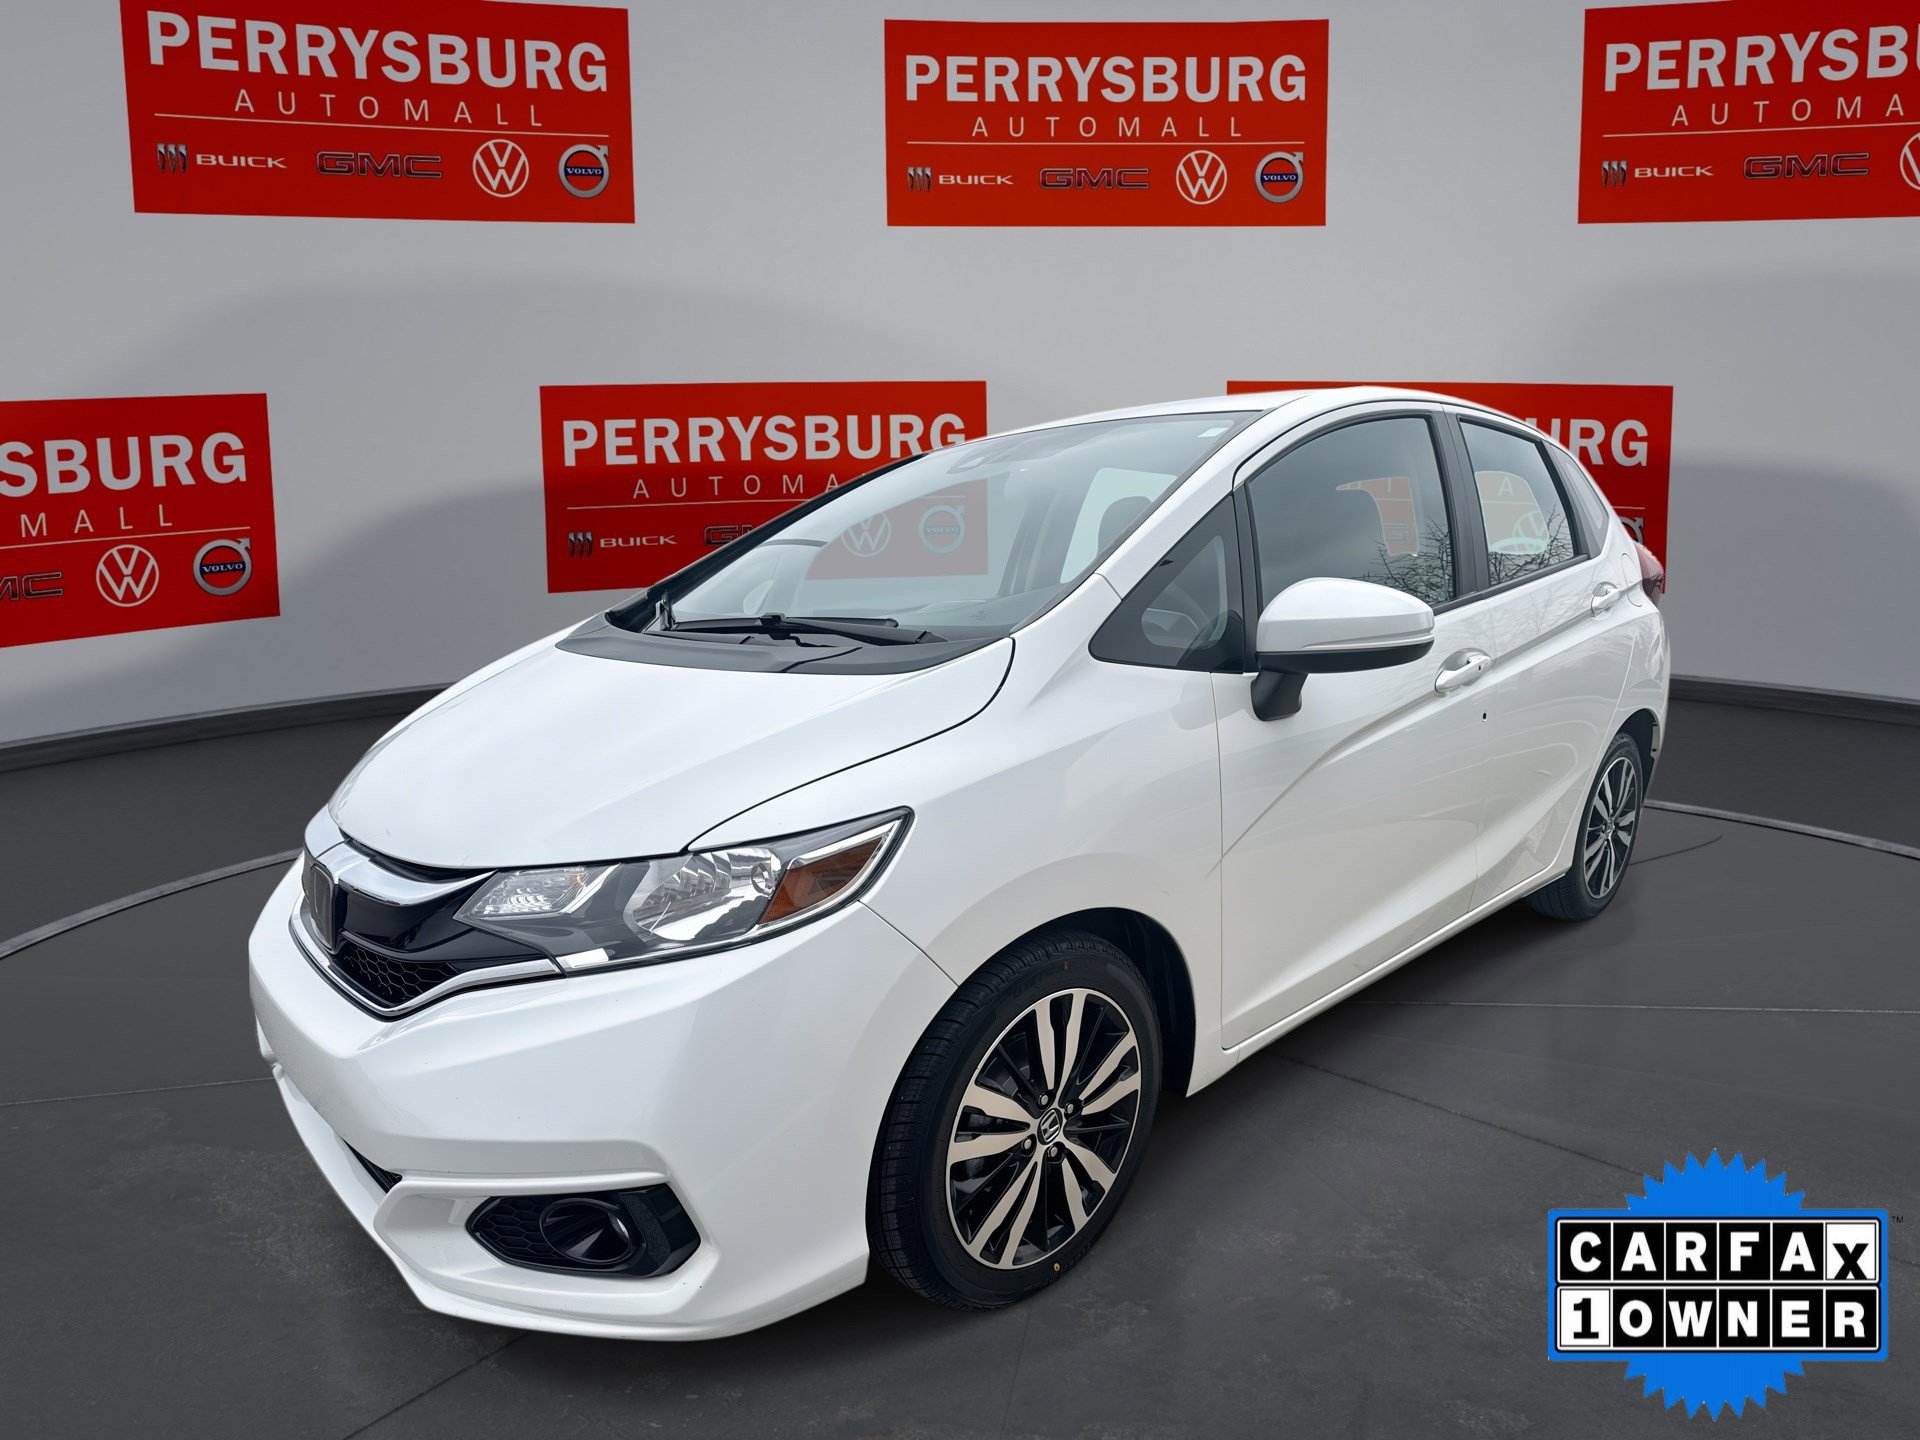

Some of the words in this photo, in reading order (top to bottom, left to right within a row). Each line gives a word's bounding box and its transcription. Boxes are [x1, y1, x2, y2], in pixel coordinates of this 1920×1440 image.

[147, 10, 608, 92] PERRYSBURG
[1604, 23, 1920, 92] PERRYSB
[905, 55, 1306, 103] PERRYSBURG
[234, 89, 542, 127] AUTOMALL
[972, 116, 1241, 137] AUTOMALL
[196, 153, 287, 169] BUICK
[316, 151, 442, 179] GMC
[566, 167, 602, 176] VOLVO
[938, 174, 1014, 185] BUICK
[1039, 167, 1149, 190] GMC
[1262, 173, 1296, 182] VOLVO
[1634, 166, 1714, 178] BUICK
[1743, 152, 1870, 179] GMC
[562, 413, 966, 467] PERRYSBURG
[600, 535, 677, 548] BUICK
[201, 562, 244, 573] VOLVO
